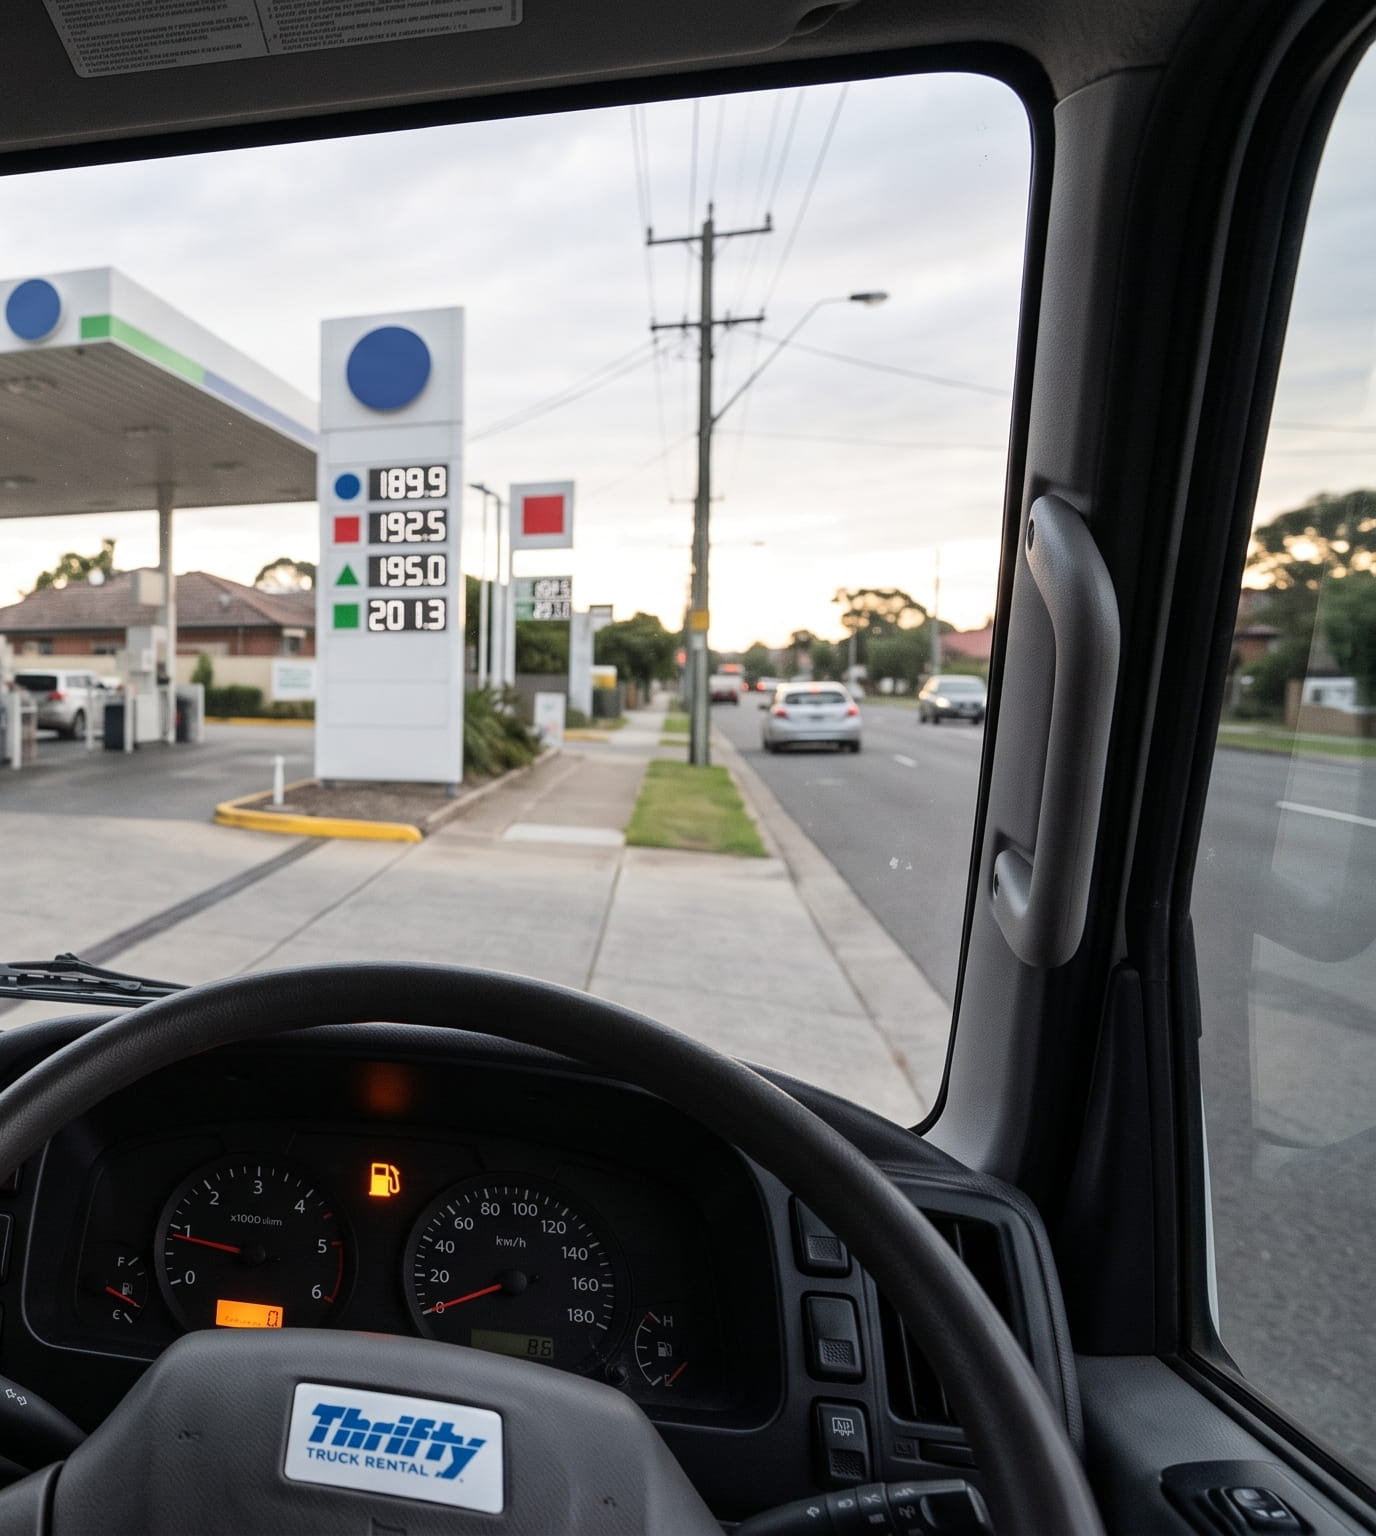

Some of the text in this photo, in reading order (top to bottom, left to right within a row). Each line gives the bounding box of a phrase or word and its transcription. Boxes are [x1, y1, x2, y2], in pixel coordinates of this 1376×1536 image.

[379, 466, 447, 499] 189.9
[379, 510, 446, 543] 192.5
[379, 554, 446, 587] 195.0
[253, 1180, 263, 1194] 3
[209, 1192, 220, 1205] 2
[294, 1200, 305, 1213] 4
[480, 1202, 501, 1216] 80
[512, 1202, 538, 1216] 100
[184, 1225, 191, 1237] 1
[454, 1217, 474, 1231] 60
[541, 1219, 567, 1234] 120
[317, 1239, 327, 1253] 5
[435, 1240, 455, 1254] 40
[495, 1235, 527, 1248] km/h
[561, 1246, 589, 1261] 140
[117, 1257, 125, 1267] F
[185, 1270, 196, 1285] 0
[430, 1269, 450, 1283] 20
[571, 1276, 599, 1291] 160
[311, 1285, 322, 1299] 6
[435, 1301, 445, 1314] 0
[567, 1308, 595, 1323] 180
[664, 1315, 673, 1327] H
[308, 1403, 488, 1480] Thrifty
[306, 1447, 429, 1477] TRUCK RENTAL
